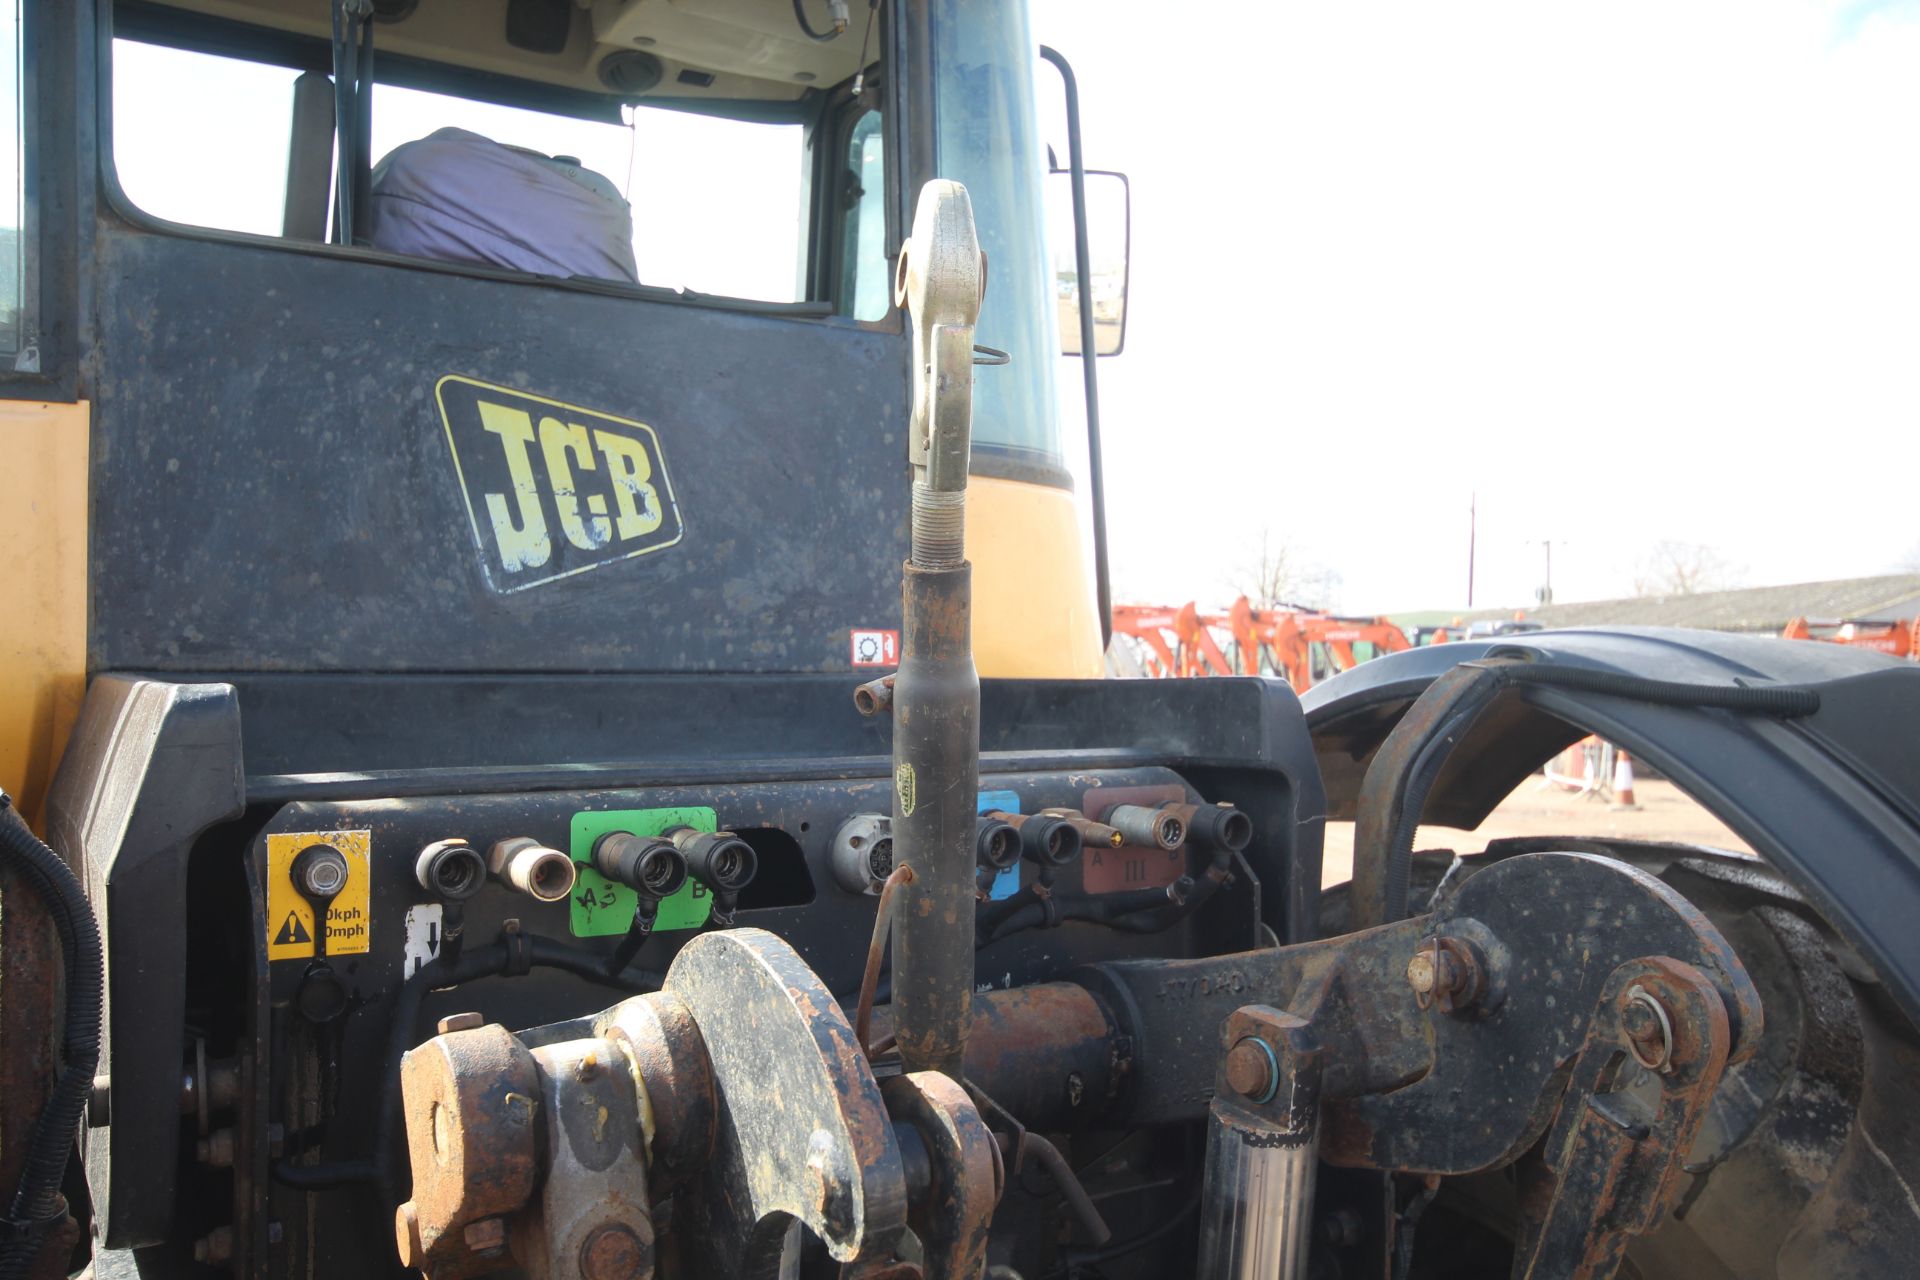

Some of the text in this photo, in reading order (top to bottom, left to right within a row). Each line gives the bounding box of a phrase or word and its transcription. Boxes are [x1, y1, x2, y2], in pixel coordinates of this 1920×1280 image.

[477, 400, 663, 573] JCB
[1092, 850, 1104, 867] A
[325, 907, 361, 922] 0kph
[325, 924, 364, 940] 0mph
